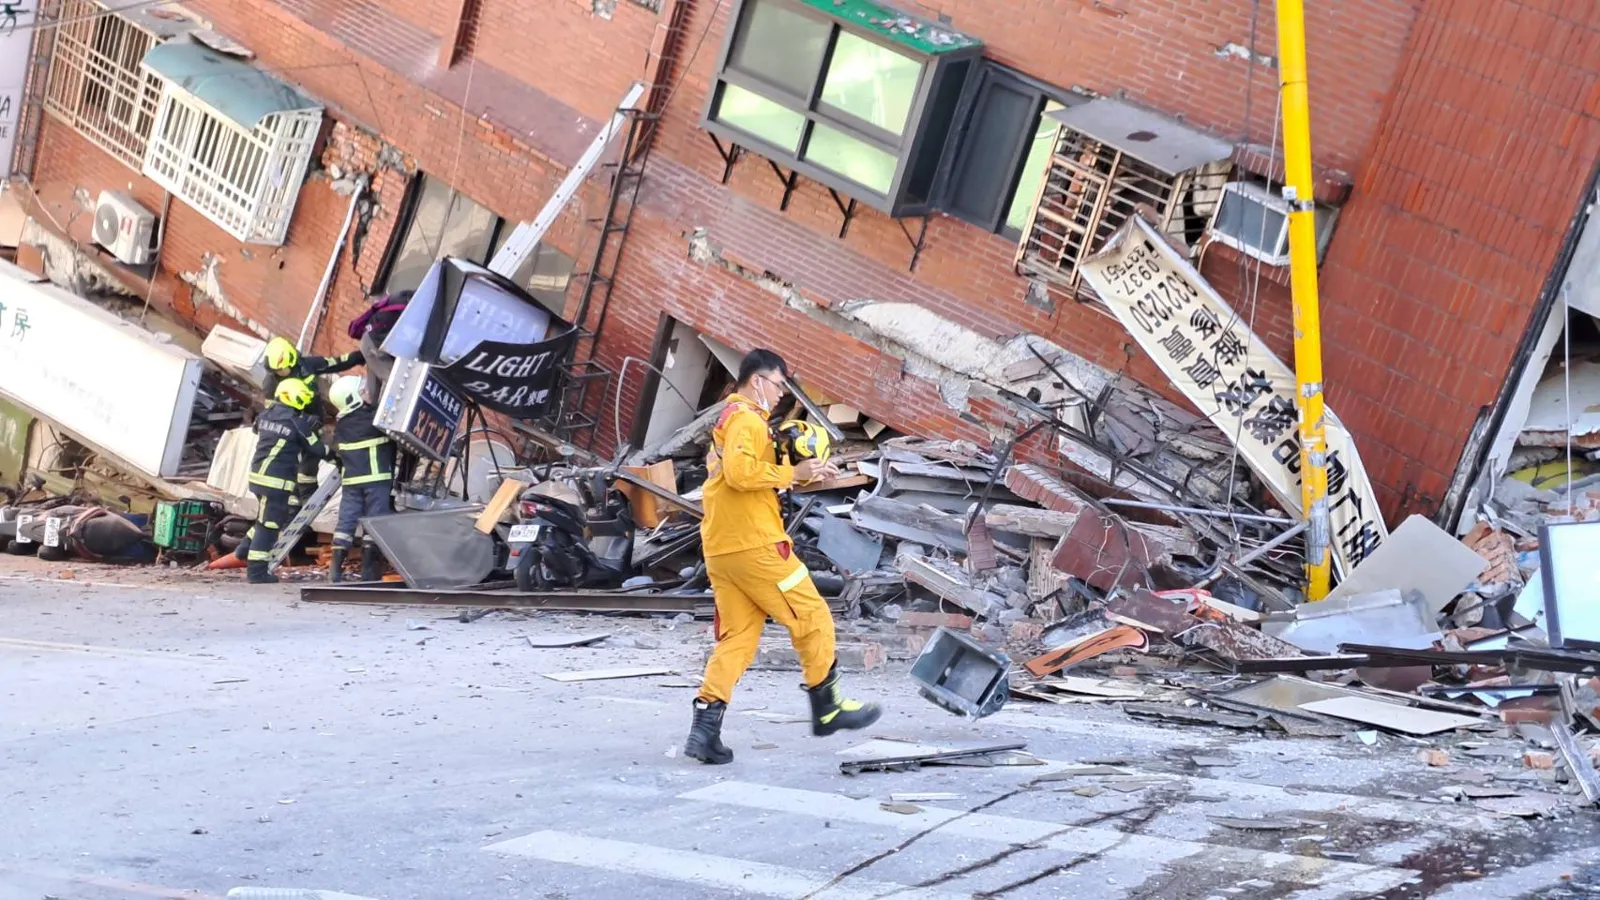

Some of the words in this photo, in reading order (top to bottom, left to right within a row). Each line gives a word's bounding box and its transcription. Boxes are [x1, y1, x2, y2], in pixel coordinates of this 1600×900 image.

[1101, 246, 1145, 285] 337551
[1129, 270, 1198, 334] 8321250
[1157, 324, 1221, 390] 買賣
[1190, 303, 1248, 367] 維修
[464, 351, 551, 378] LIGHT
[462, 381, 529, 407] BAR
